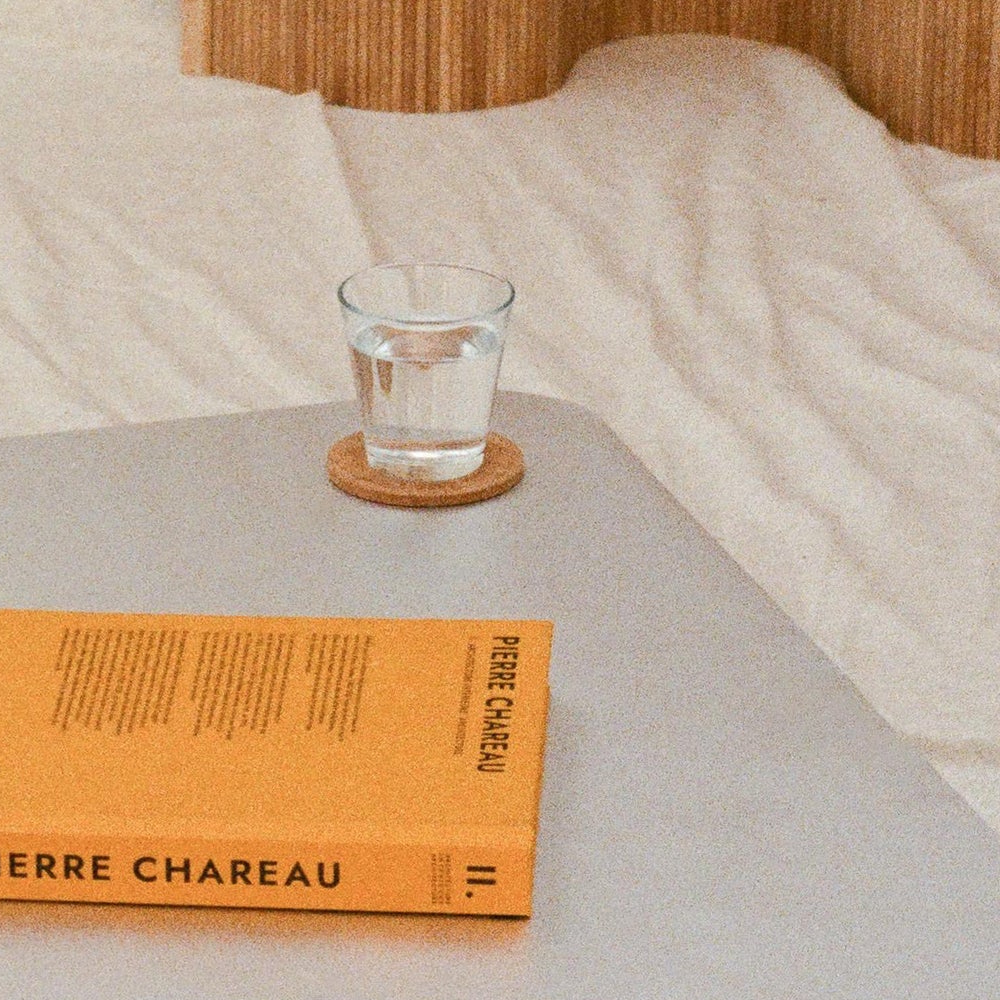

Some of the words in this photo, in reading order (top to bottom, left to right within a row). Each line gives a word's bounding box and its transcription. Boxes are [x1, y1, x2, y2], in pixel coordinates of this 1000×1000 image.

[488, 636, 520, 691] PIERRE
[477, 697, 514, 773] CHAREAU
[132, 856, 342, 889] CHAREAU
